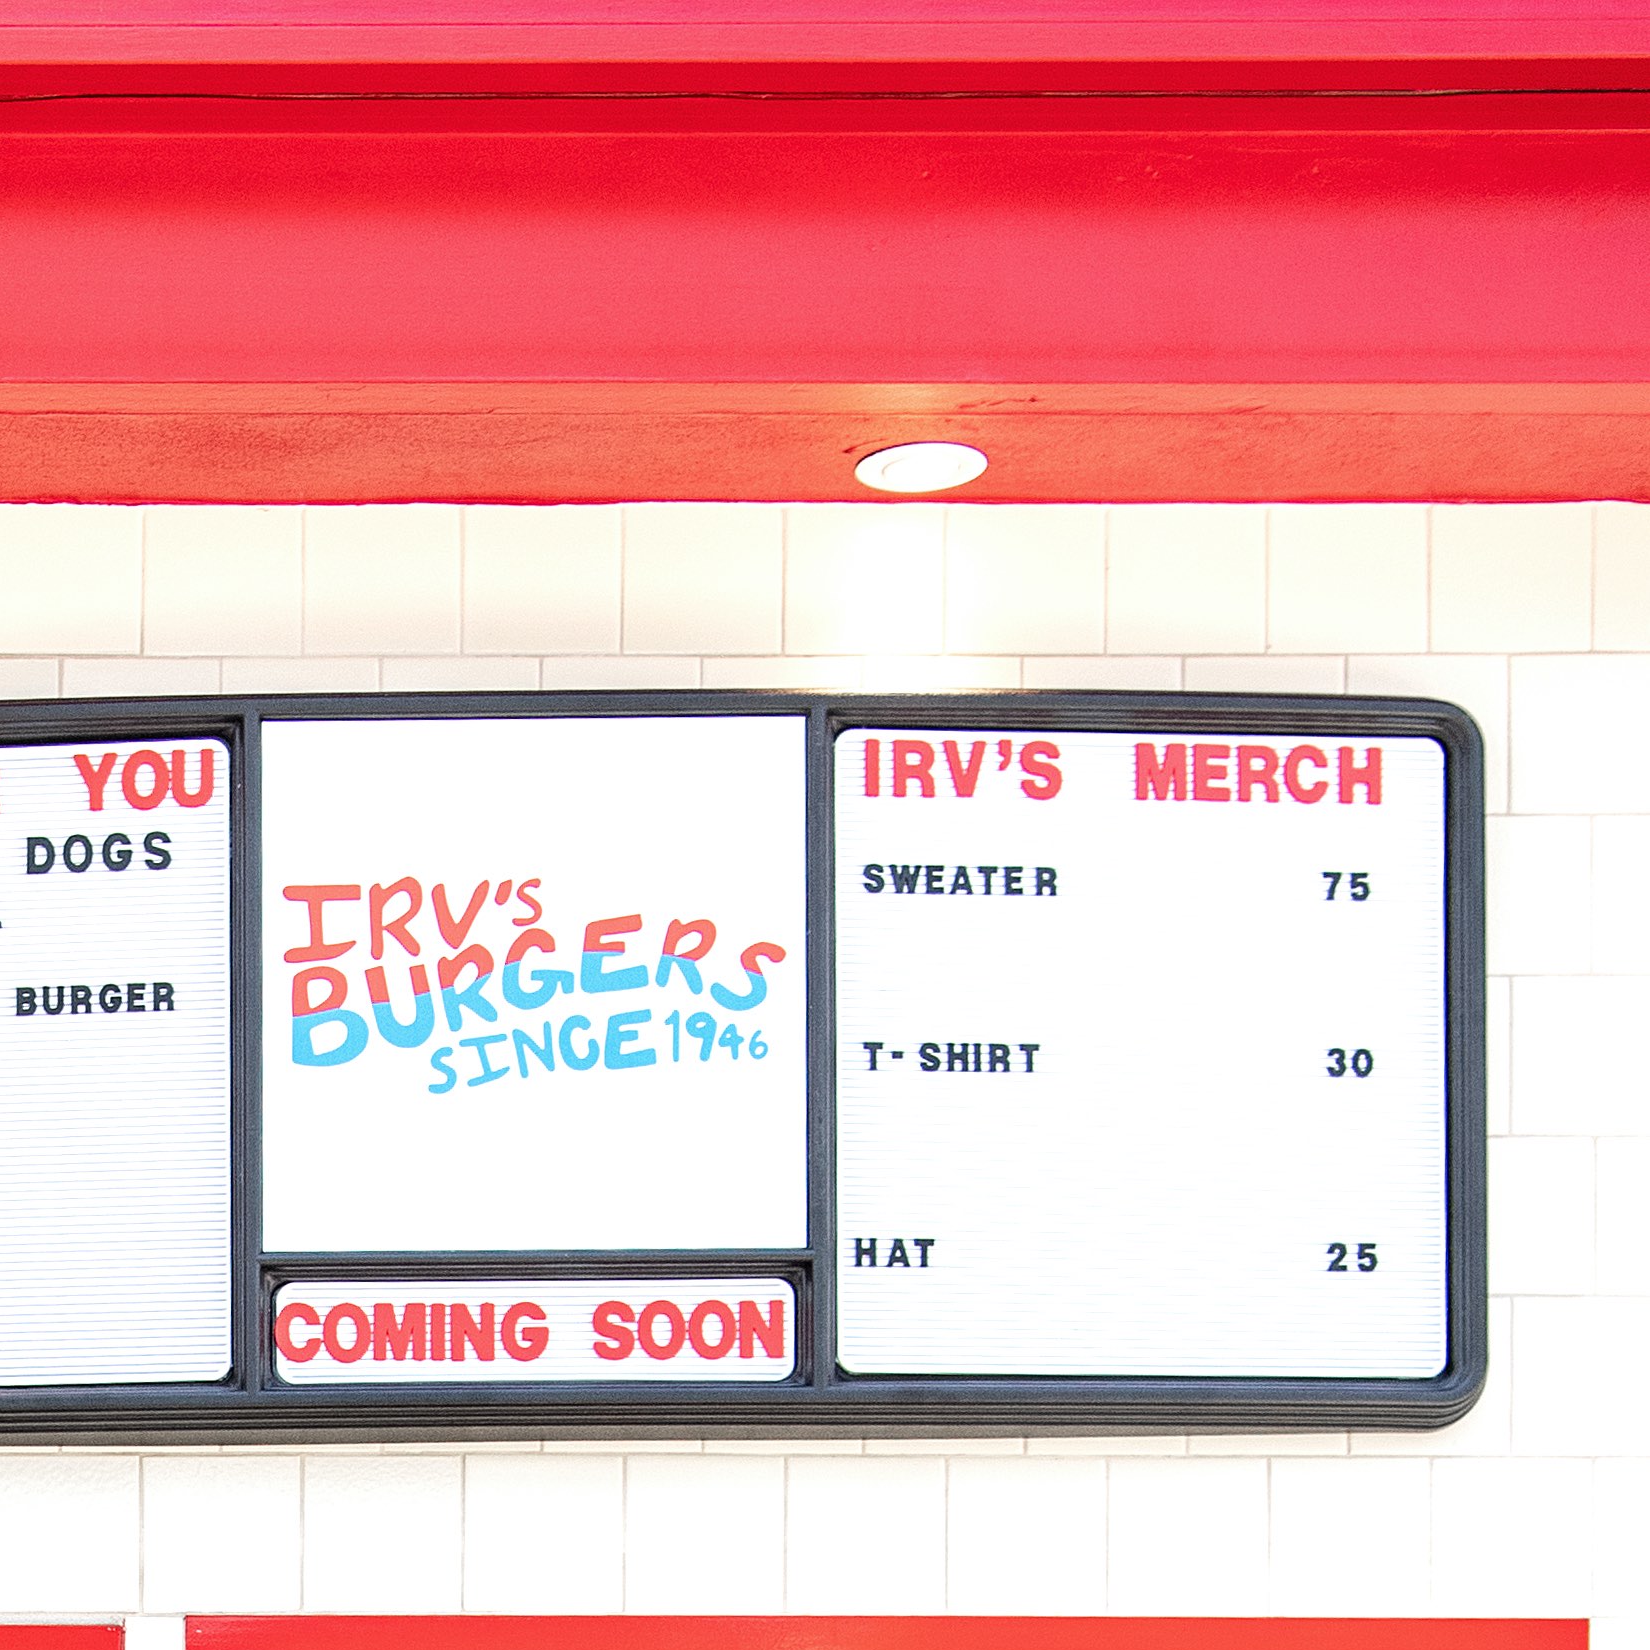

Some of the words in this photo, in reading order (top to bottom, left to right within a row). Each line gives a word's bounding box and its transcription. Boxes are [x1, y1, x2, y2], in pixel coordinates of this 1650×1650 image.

[74, 749, 214, 812] YOU
[864, 739, 1062, 800] IRV'S
[1134, 743, 1382, 805] MERCH
[27, 832, 171, 874] DOGS
[863, 864, 1056, 896] SWEATER
[1323, 872, 1369, 901] 75
[282, 877, 542, 965] IRV'S
[16, 983, 174, 1016] BURGER
[290, 912, 787, 1068] BURGERS
[427, 1008, 657, 1094] SINCE
[665, 1007, 768, 1062] 1946
[1327, 1049, 1373, 1077] 30
[854, 1238, 934, 1267] HAT
[1327, 1243, 1377, 1272] 25
[274, 1302, 549, 1363] COMING
[592, 1300, 784, 1360] SOON
